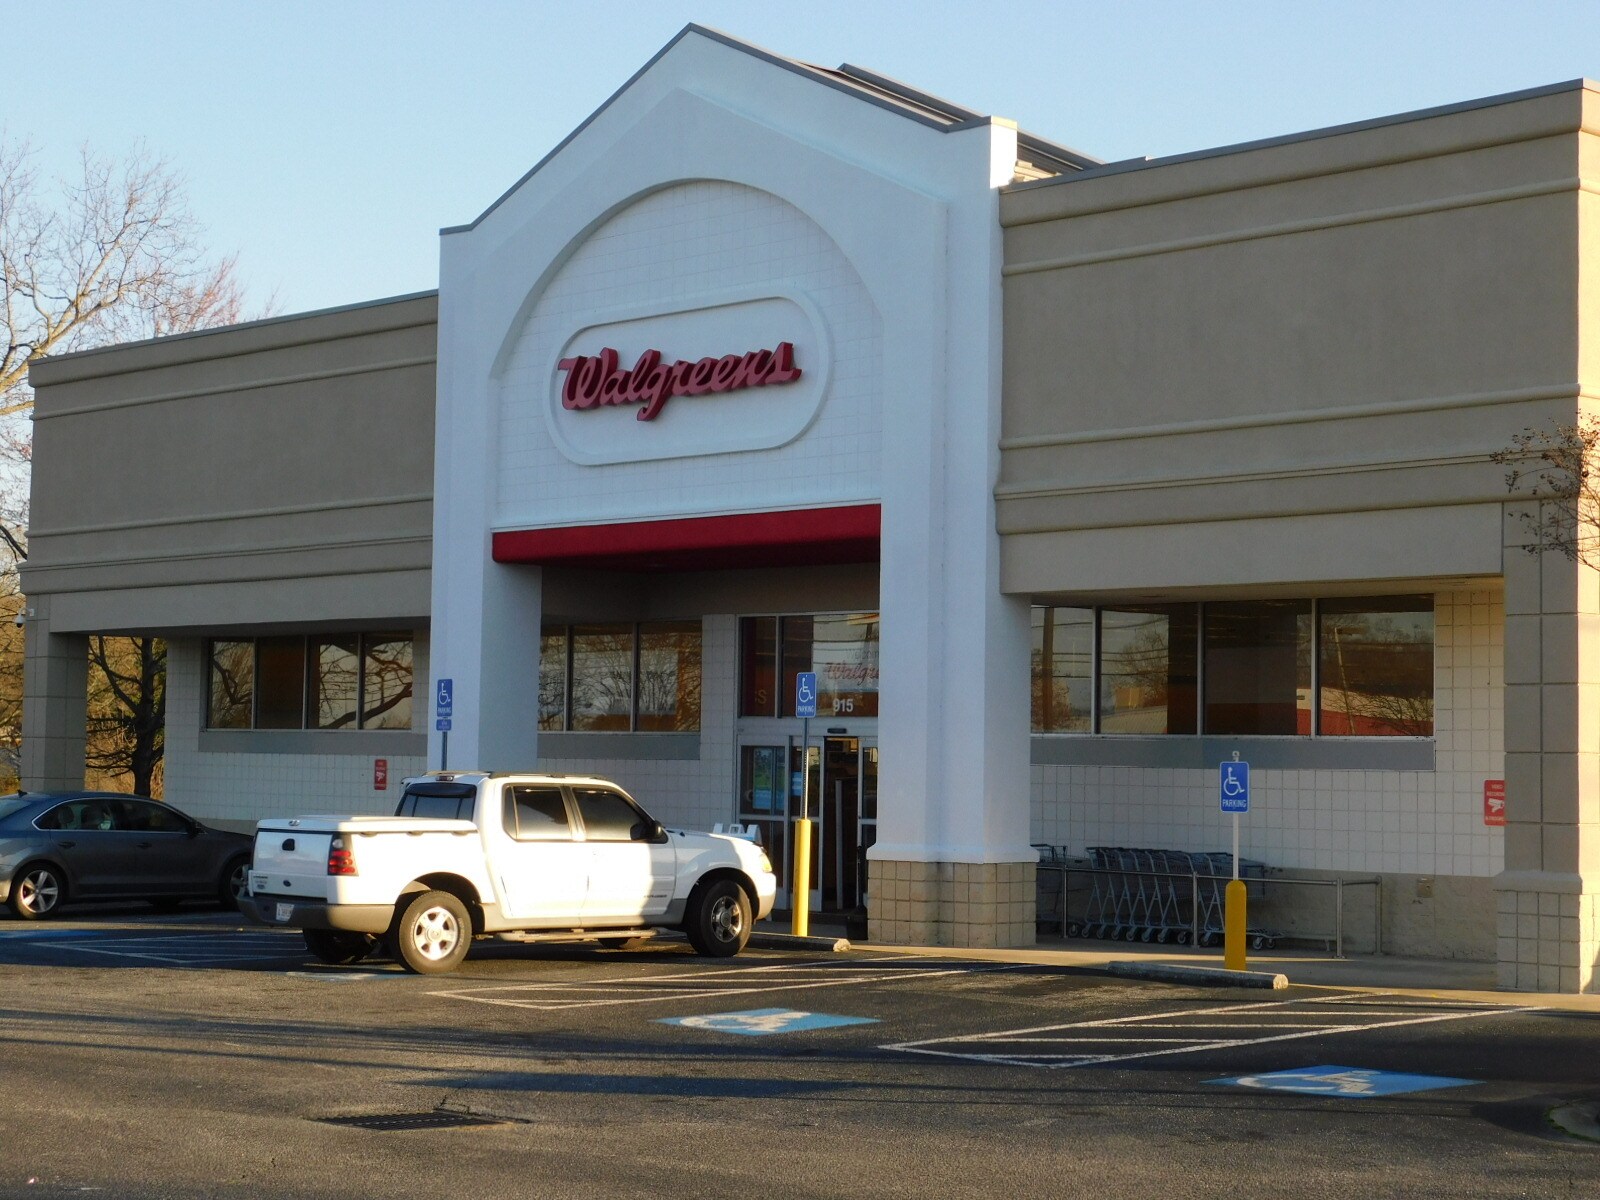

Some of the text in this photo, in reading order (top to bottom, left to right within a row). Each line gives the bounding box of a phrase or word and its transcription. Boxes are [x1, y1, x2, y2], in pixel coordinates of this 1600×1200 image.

[557, 341, 802, 421] Walgreens
[823, 661, 879, 686] Walgr
[797, 705, 815, 713] PARKING
[833, 698, 853, 712] 915
[1222, 799, 1247, 808] PARKING
